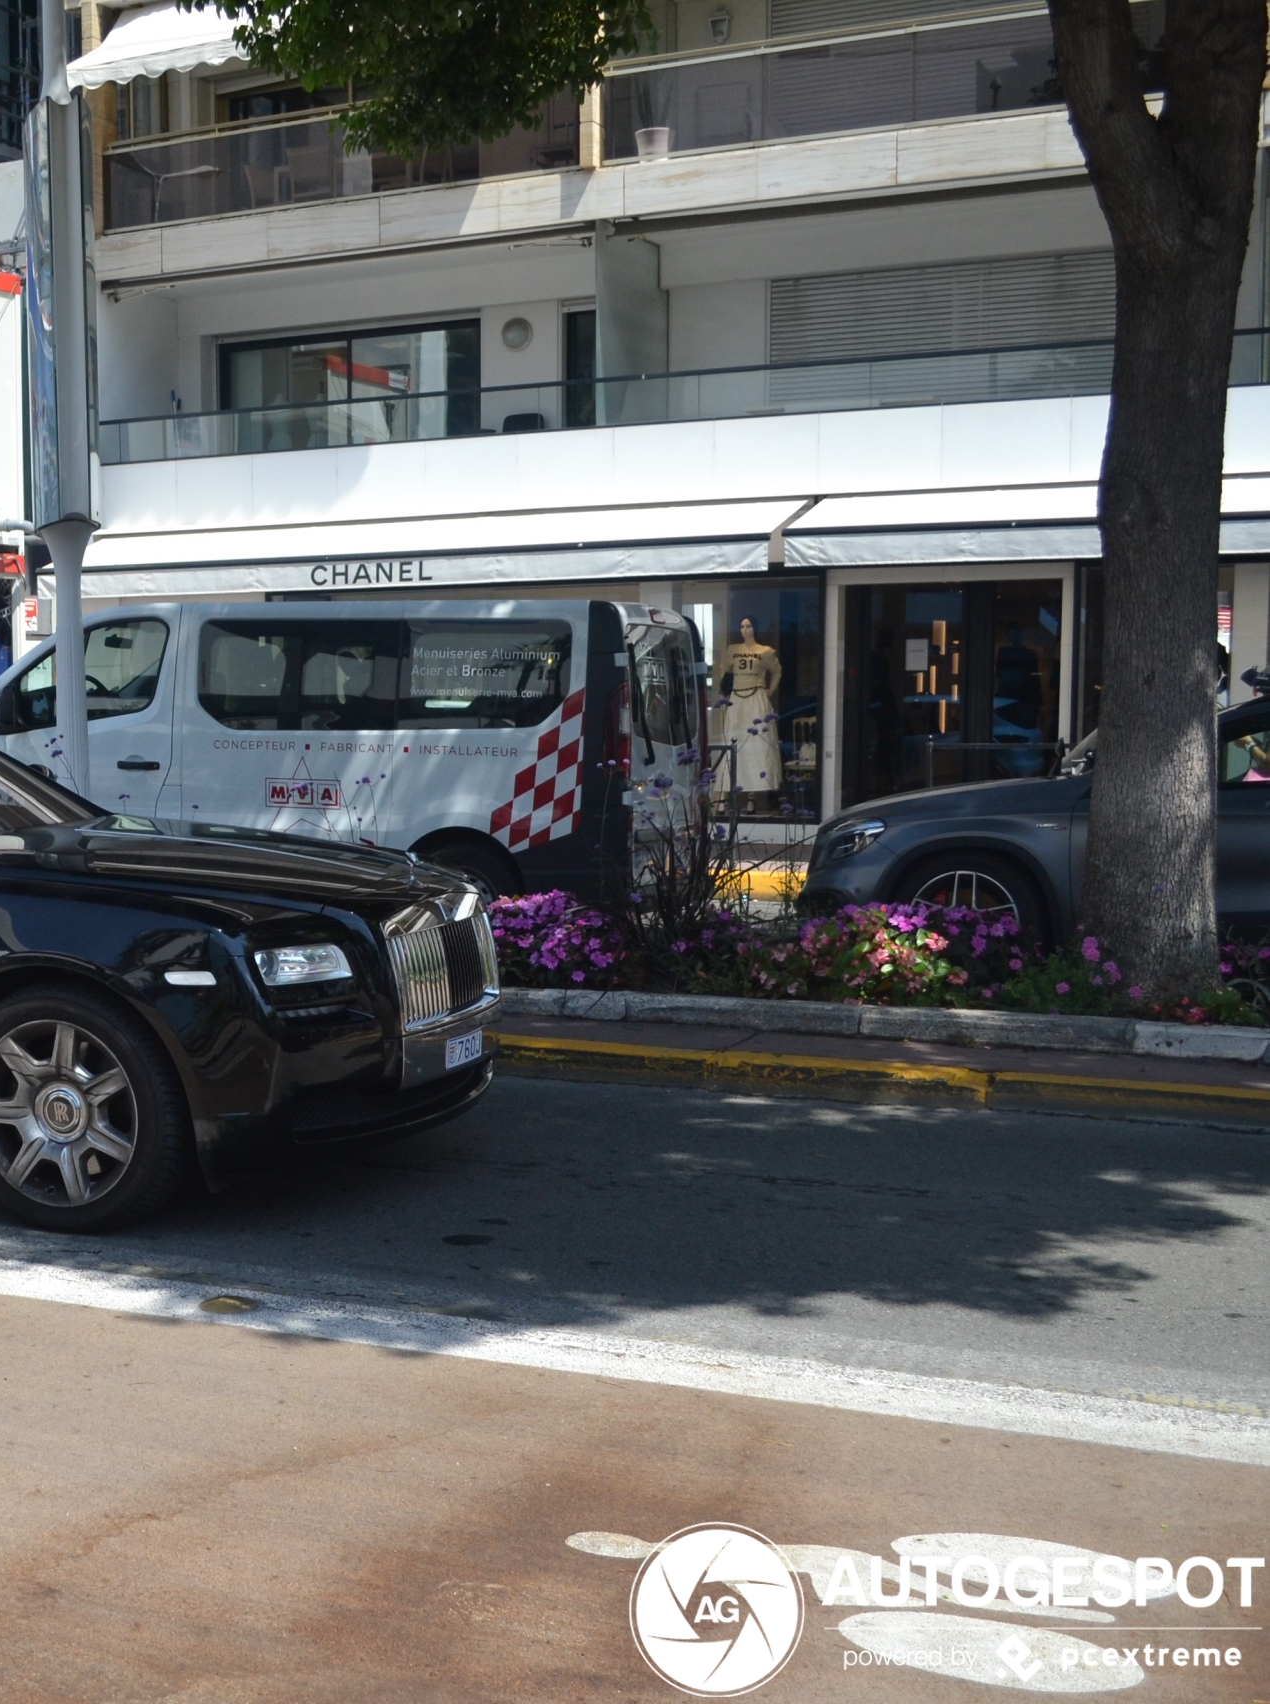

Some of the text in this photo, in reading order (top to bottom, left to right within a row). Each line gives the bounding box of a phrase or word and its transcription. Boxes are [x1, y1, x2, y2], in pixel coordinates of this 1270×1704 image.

[310, 560, 433, 586] CHANEL
[412, 647, 560, 661] Menuiseries Aluminium
[411, 664, 506, 677] Acier et Bronze
[739, 659, 754, 670] 31
[410, 686, 543, 699] www.menuiserie-mva.com
[213, 740, 518, 757] CONCEPTEUR FABRICANT INSTALLATEUR
